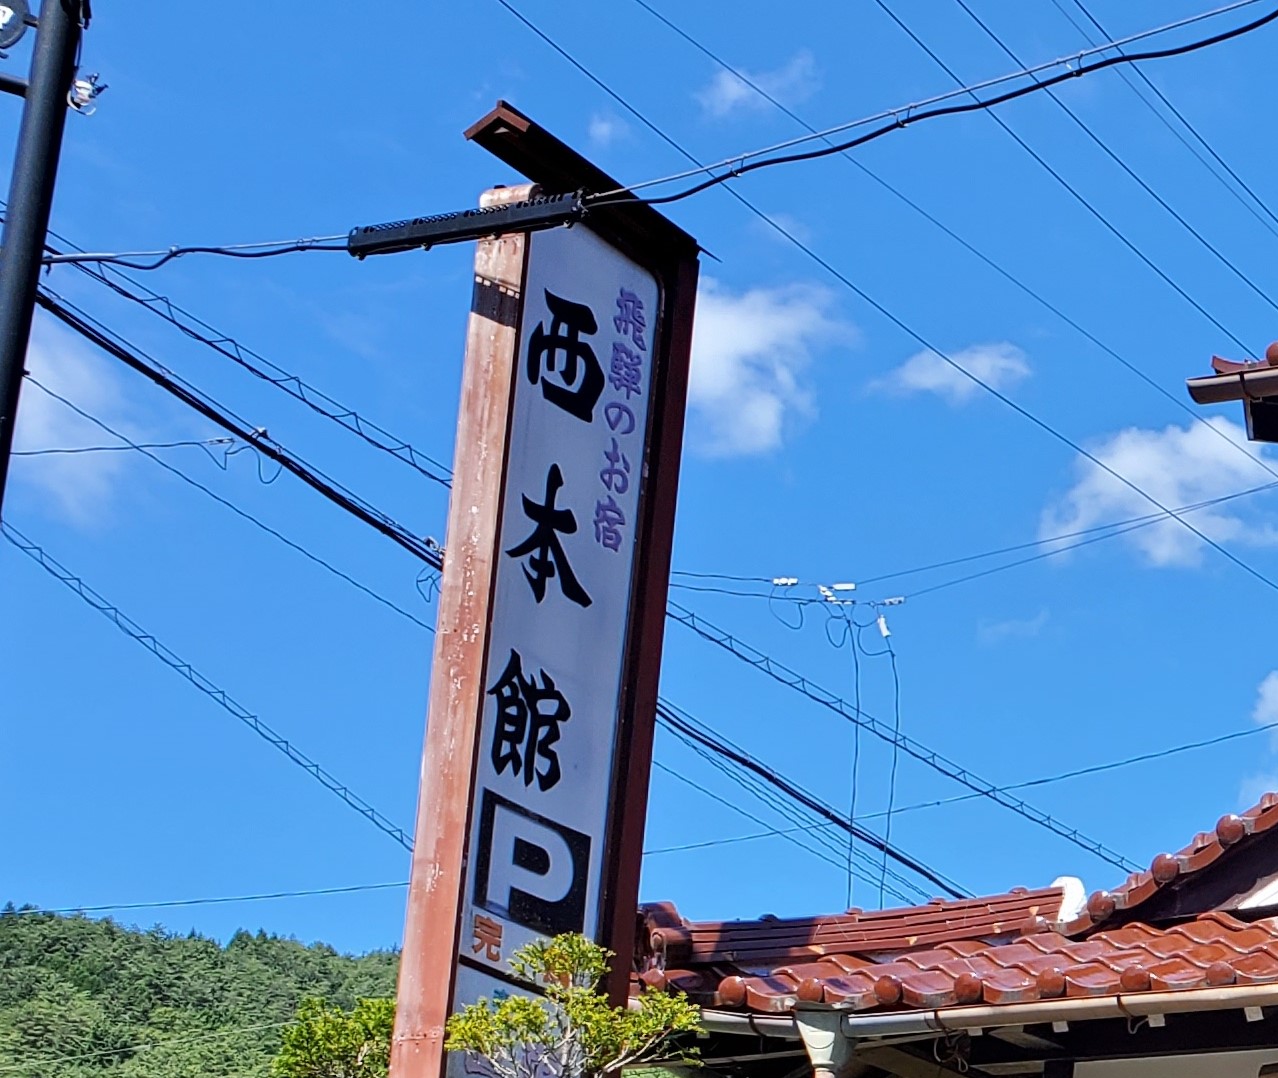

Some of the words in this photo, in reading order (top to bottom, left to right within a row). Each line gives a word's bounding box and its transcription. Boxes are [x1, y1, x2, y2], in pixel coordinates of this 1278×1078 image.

[487, 287, 605, 792] 西本館
[593, 286, 647, 553] 飛騨のお宿
[486, 804, 574, 914] P
